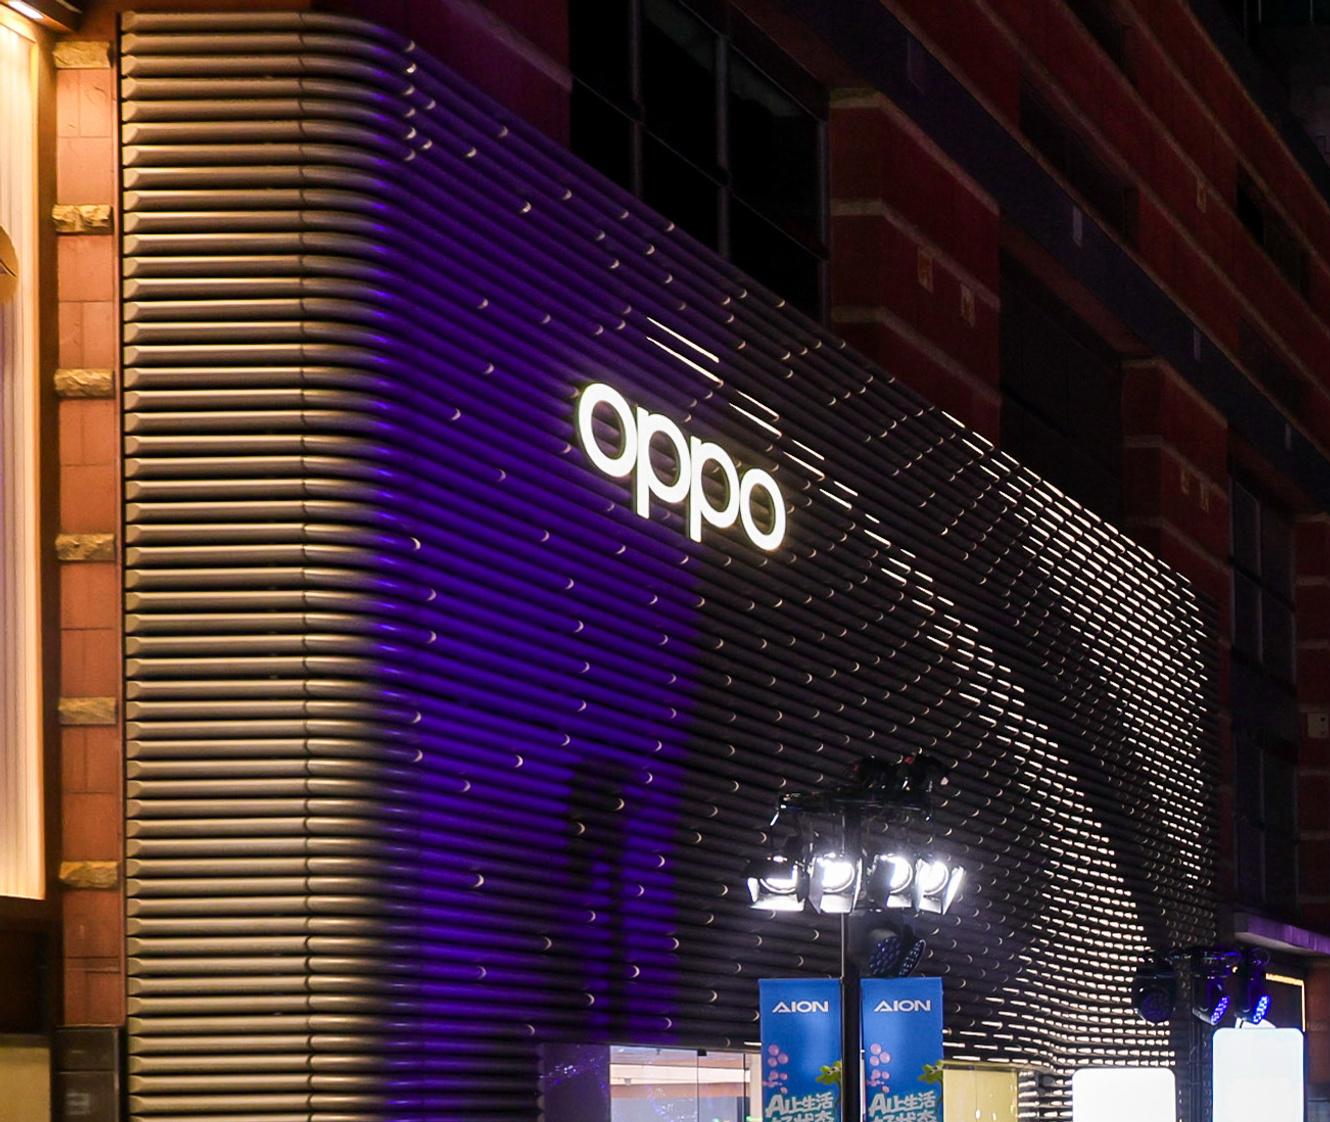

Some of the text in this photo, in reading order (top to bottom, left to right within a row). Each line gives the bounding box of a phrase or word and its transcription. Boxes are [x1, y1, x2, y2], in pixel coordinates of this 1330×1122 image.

[579, 383, 786, 550] oppo
[772, 1001, 829, 1013] AION
[874, 1000, 931, 1012] AION
